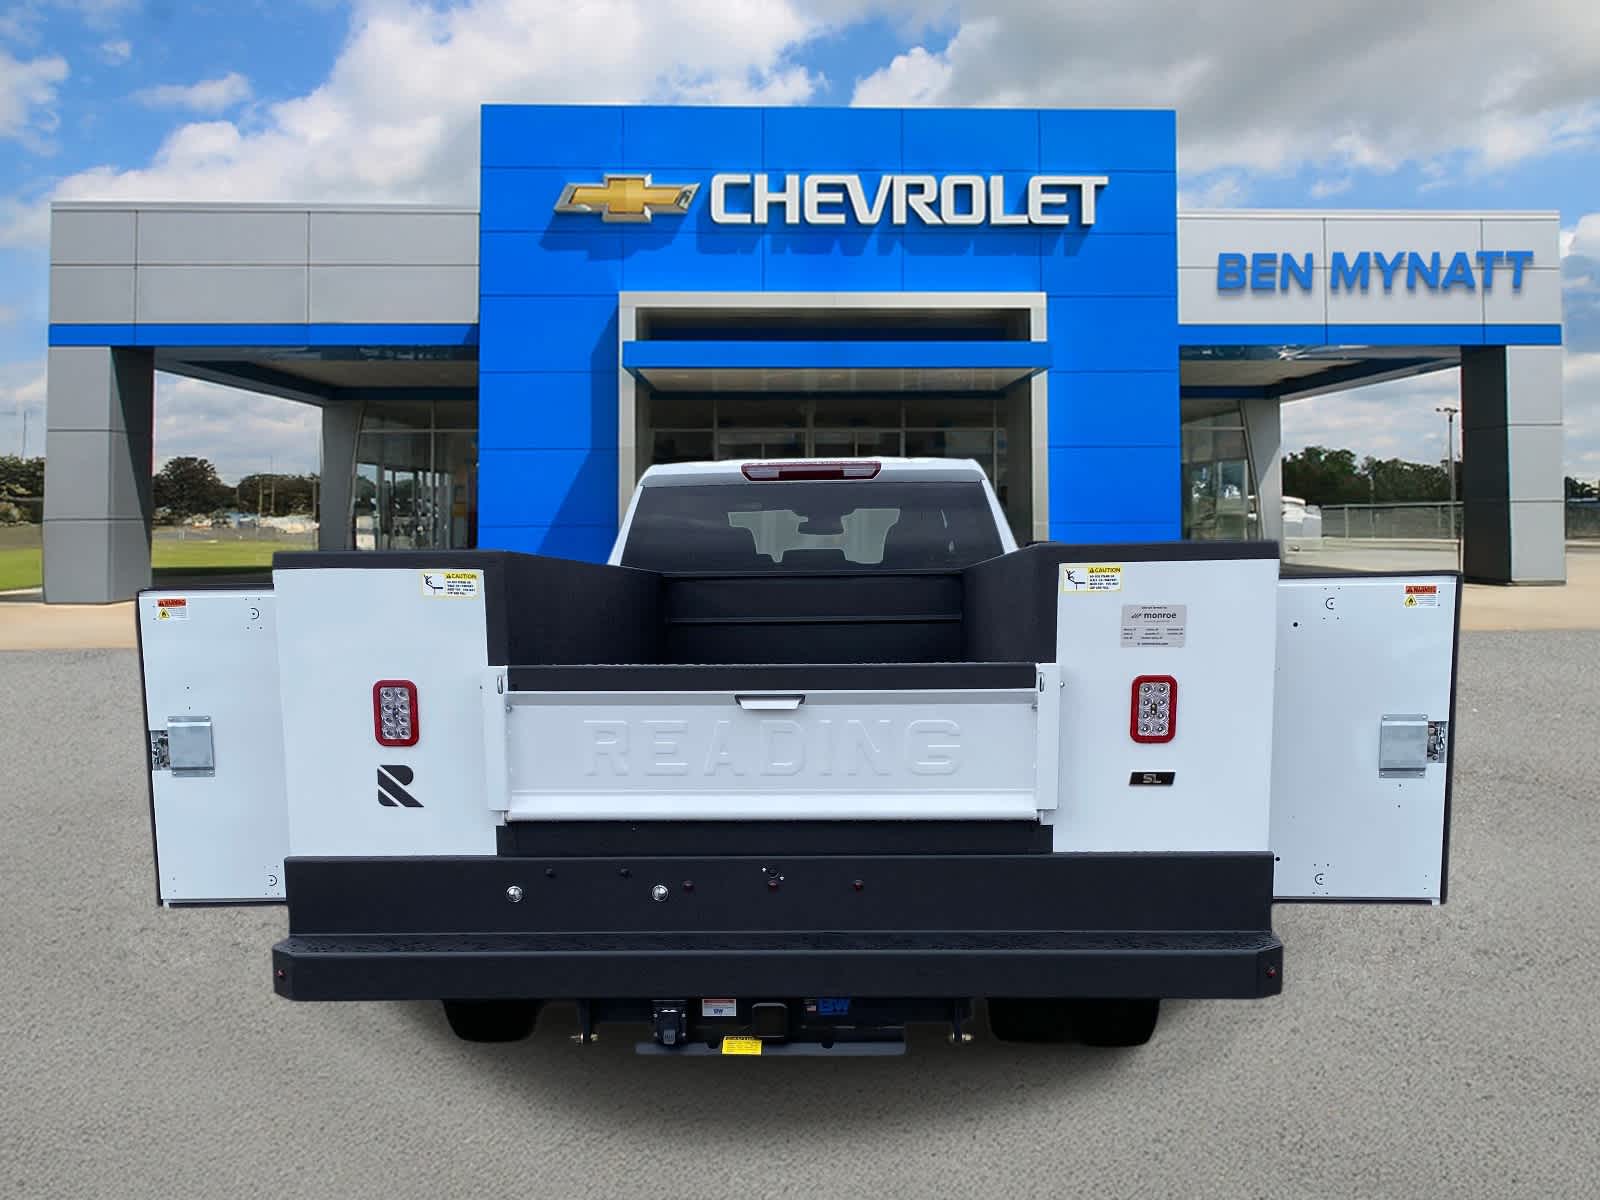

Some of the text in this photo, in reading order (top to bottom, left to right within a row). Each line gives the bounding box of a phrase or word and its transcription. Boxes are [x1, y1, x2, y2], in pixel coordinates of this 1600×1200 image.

[710, 173, 1110, 226] CHEVROLET
[1216, 250, 1535, 291] BEN MYNATT
[1143, 611, 1177, 619] monroe
[583, 719, 961, 777] READING
[1142, 773, 1162, 784] SL
